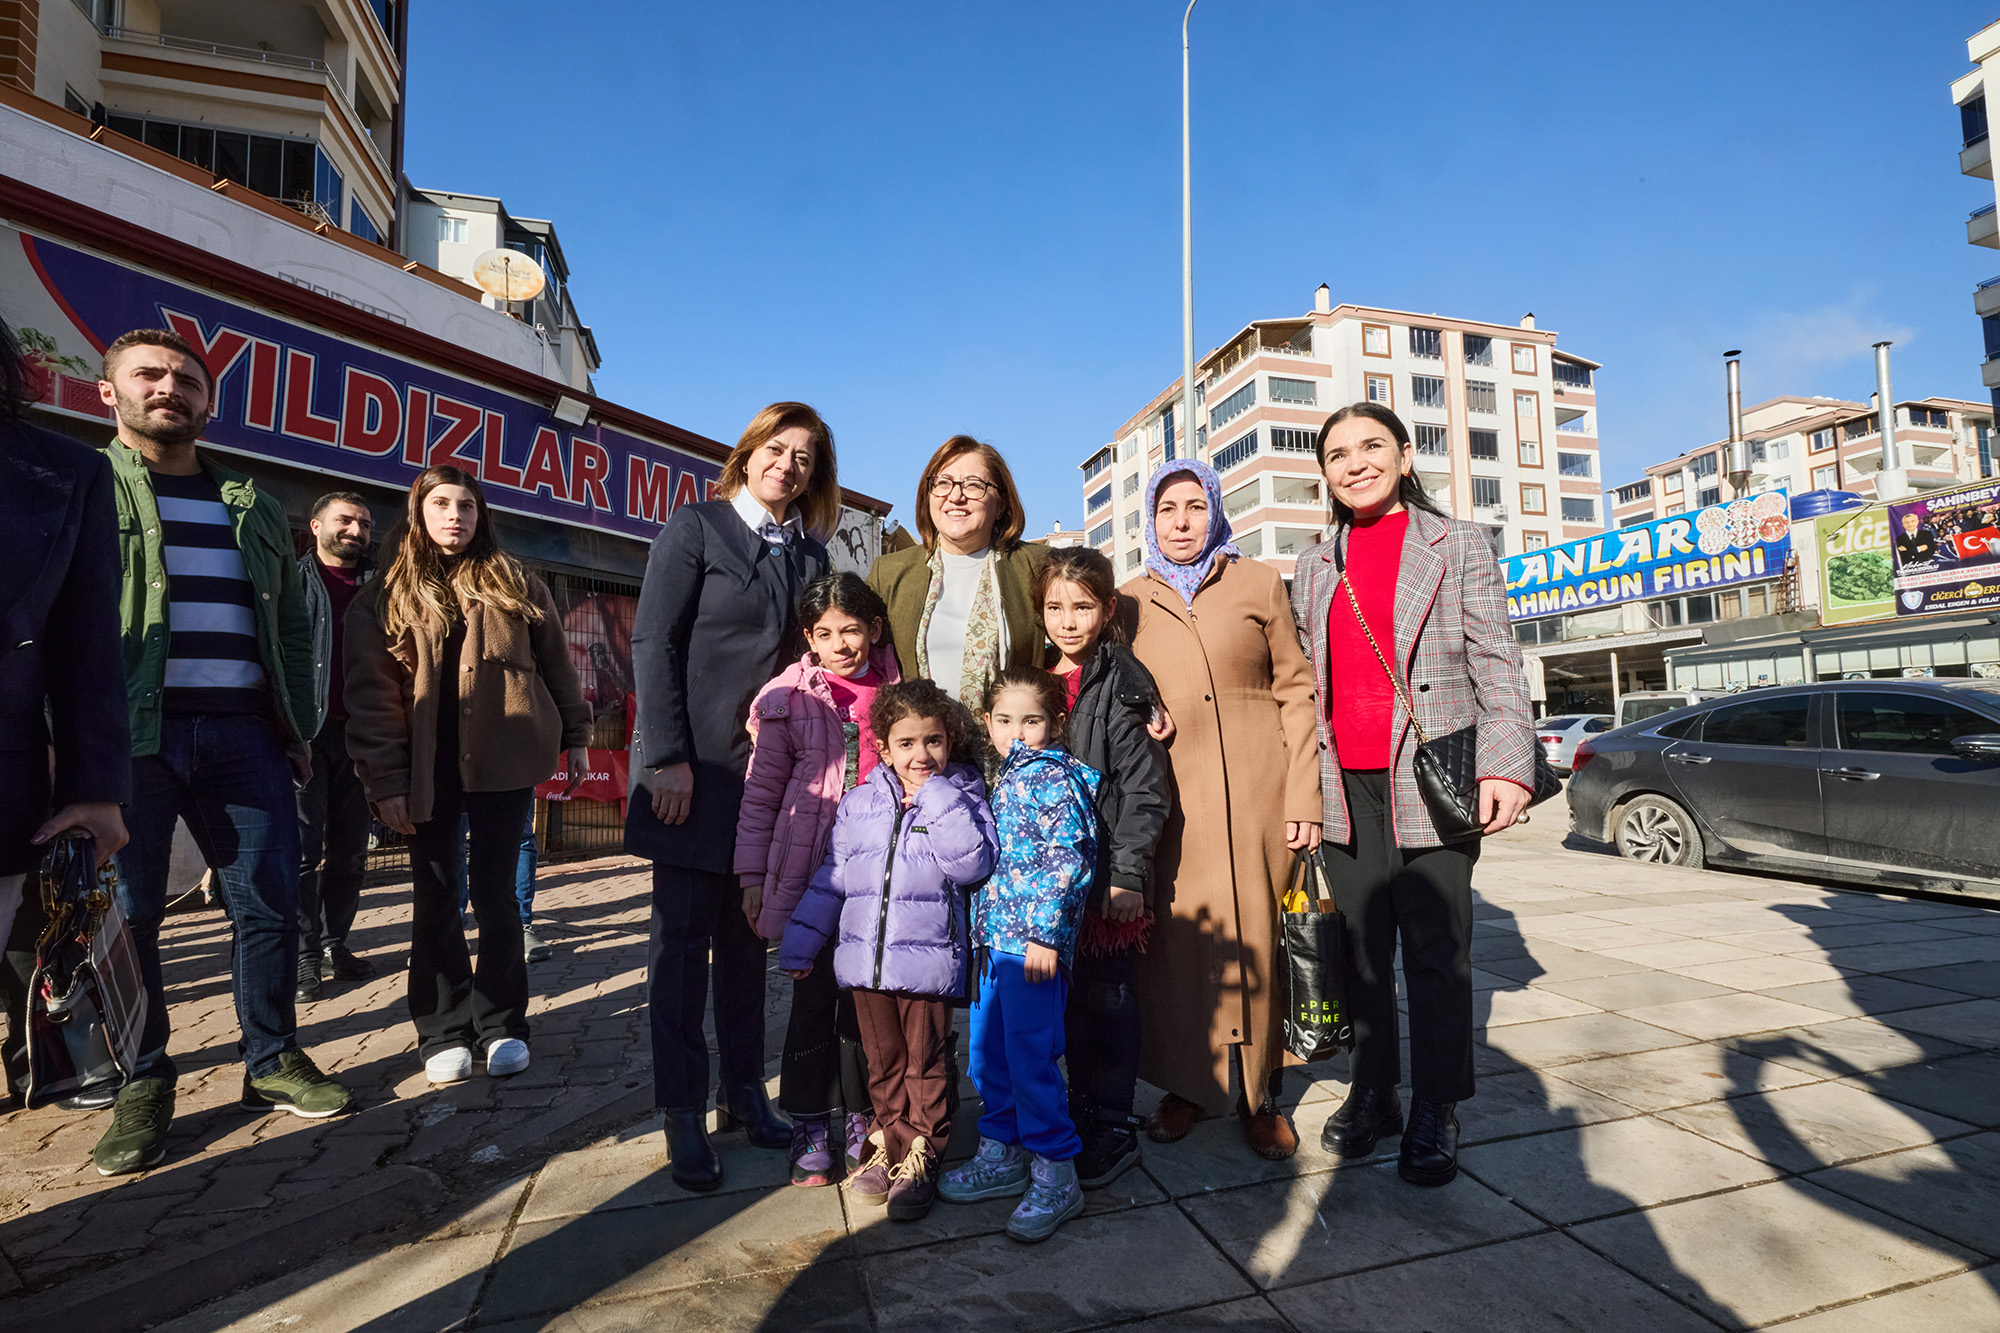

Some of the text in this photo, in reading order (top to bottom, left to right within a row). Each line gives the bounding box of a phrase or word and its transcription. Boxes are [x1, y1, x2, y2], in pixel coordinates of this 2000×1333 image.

[160, 306, 612, 513] YILDIZLAR
[1653, 547, 1766, 592] FIRINI
[1301, 1012, 1340, 1024] FUME
